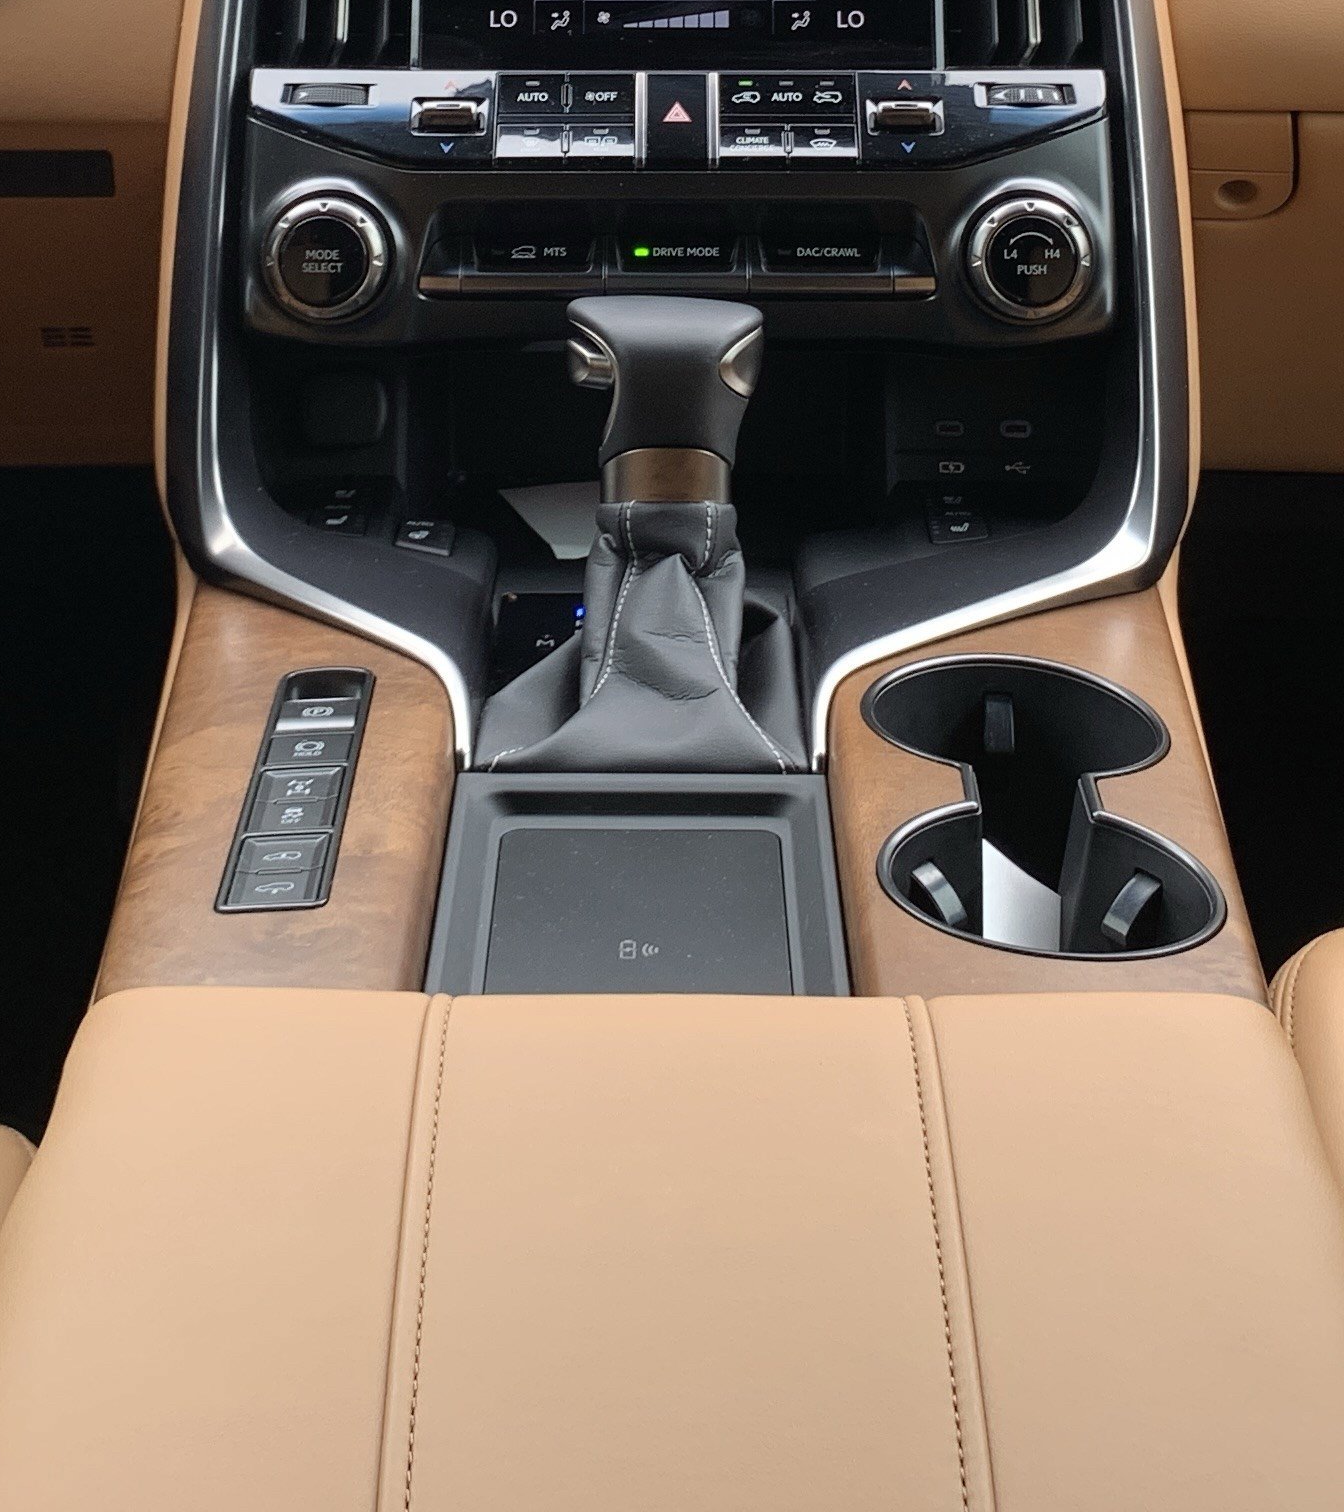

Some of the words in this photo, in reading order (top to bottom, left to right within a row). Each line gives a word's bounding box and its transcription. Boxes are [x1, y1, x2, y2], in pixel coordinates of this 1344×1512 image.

[489, 10, 518, 29] LO
[837, 10, 865, 29] LO
[516, 91, 549, 102] AUTO
[595, 91, 618, 102] OFF
[771, 91, 803, 102] AUTO
[736, 136, 770, 145] CLIMATE
[305, 248, 340, 262] MODE
[542, 246, 568, 258] MTS
[652, 246, 685, 258] DRIVE
[687, 246, 720, 258] MODE
[796, 246, 862, 259] DAC/CRAWL
[1003, 247, 1018, 261] L4
[1044, 247, 1061, 261] H4
[302, 260, 344, 274] SELECT
[1016, 263, 1047, 276] PUSH
